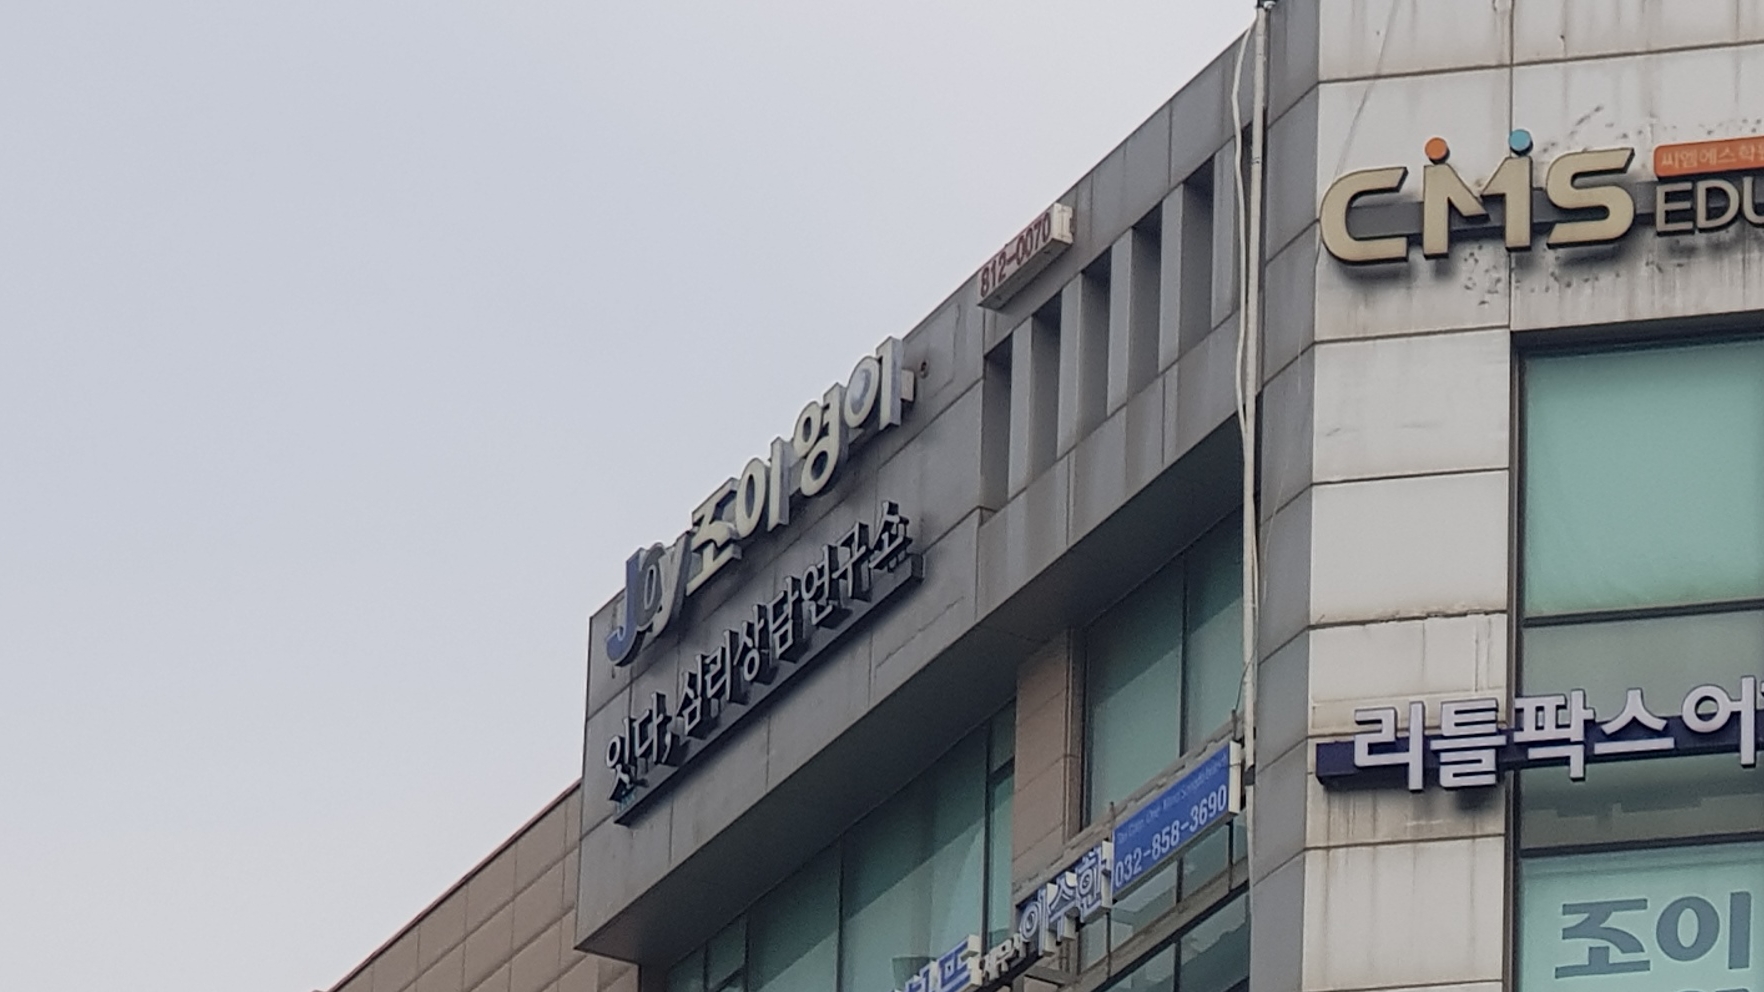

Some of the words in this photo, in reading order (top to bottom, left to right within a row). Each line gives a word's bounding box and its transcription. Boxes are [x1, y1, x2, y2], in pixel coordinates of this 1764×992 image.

[1320, 129, 1635, 263] CMS
[686, 336, 901, 598] 조이영어
[606, 531, 692, 666] Joy
[1115, 784, 1227, 888] 032-858-3690
[1555, 891, 1751, 979] 조이
